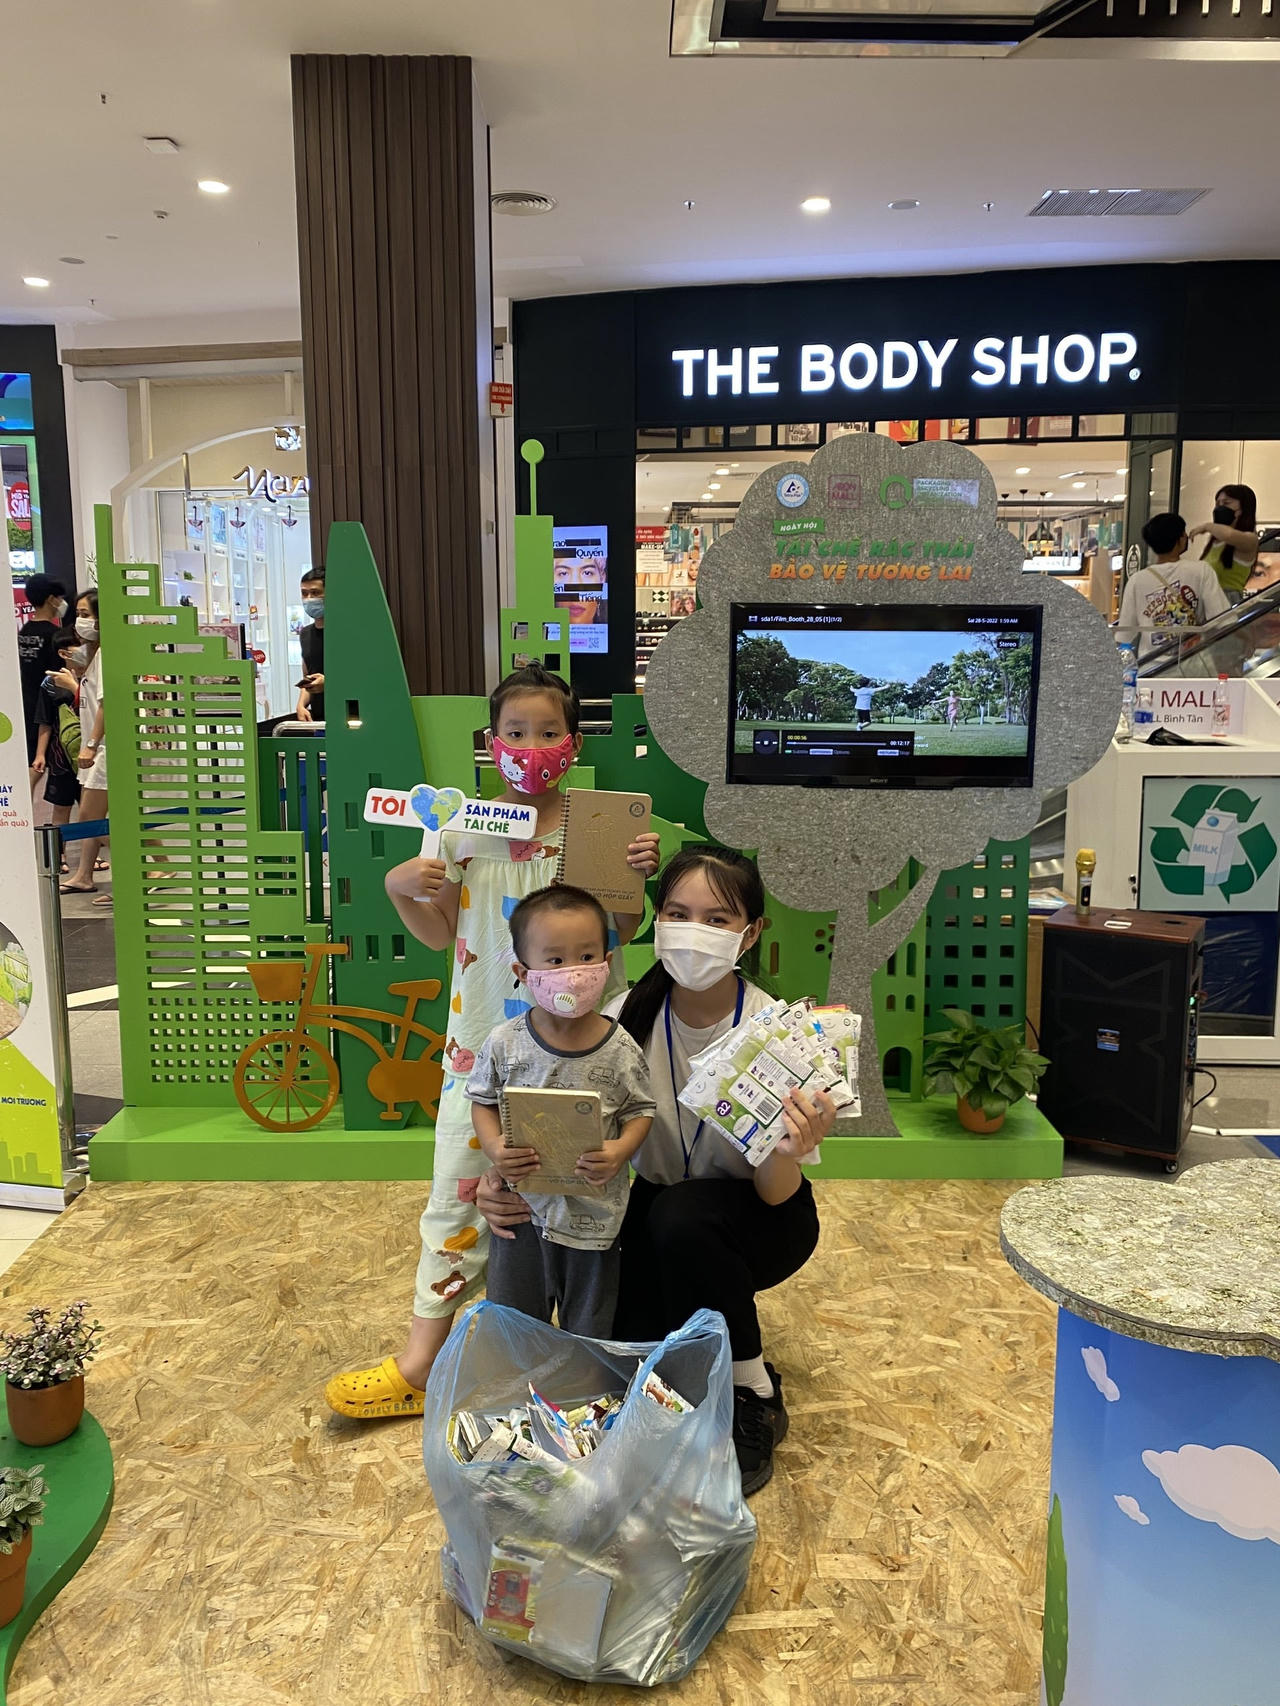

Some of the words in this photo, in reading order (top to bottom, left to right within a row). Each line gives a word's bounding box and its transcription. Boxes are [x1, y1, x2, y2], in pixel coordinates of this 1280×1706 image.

[672, 346, 780, 397] THE
[800, 338, 959, 393] BODY
[775, 537, 811, 557] TÁI
[868, 536, 916, 557] RÁC
[923, 535, 975, 558] THẢI
[768, 558, 815, 580] BẢO
[856, 562, 931, 581] TƯƠNG
[938, 565, 973, 581] LAI
[1161, 690, 1223, 708] MALL
[371, 795, 406, 817] TÔI
[1192, 844, 1218, 855] MILK
[716, 1101, 731, 1116] a2
